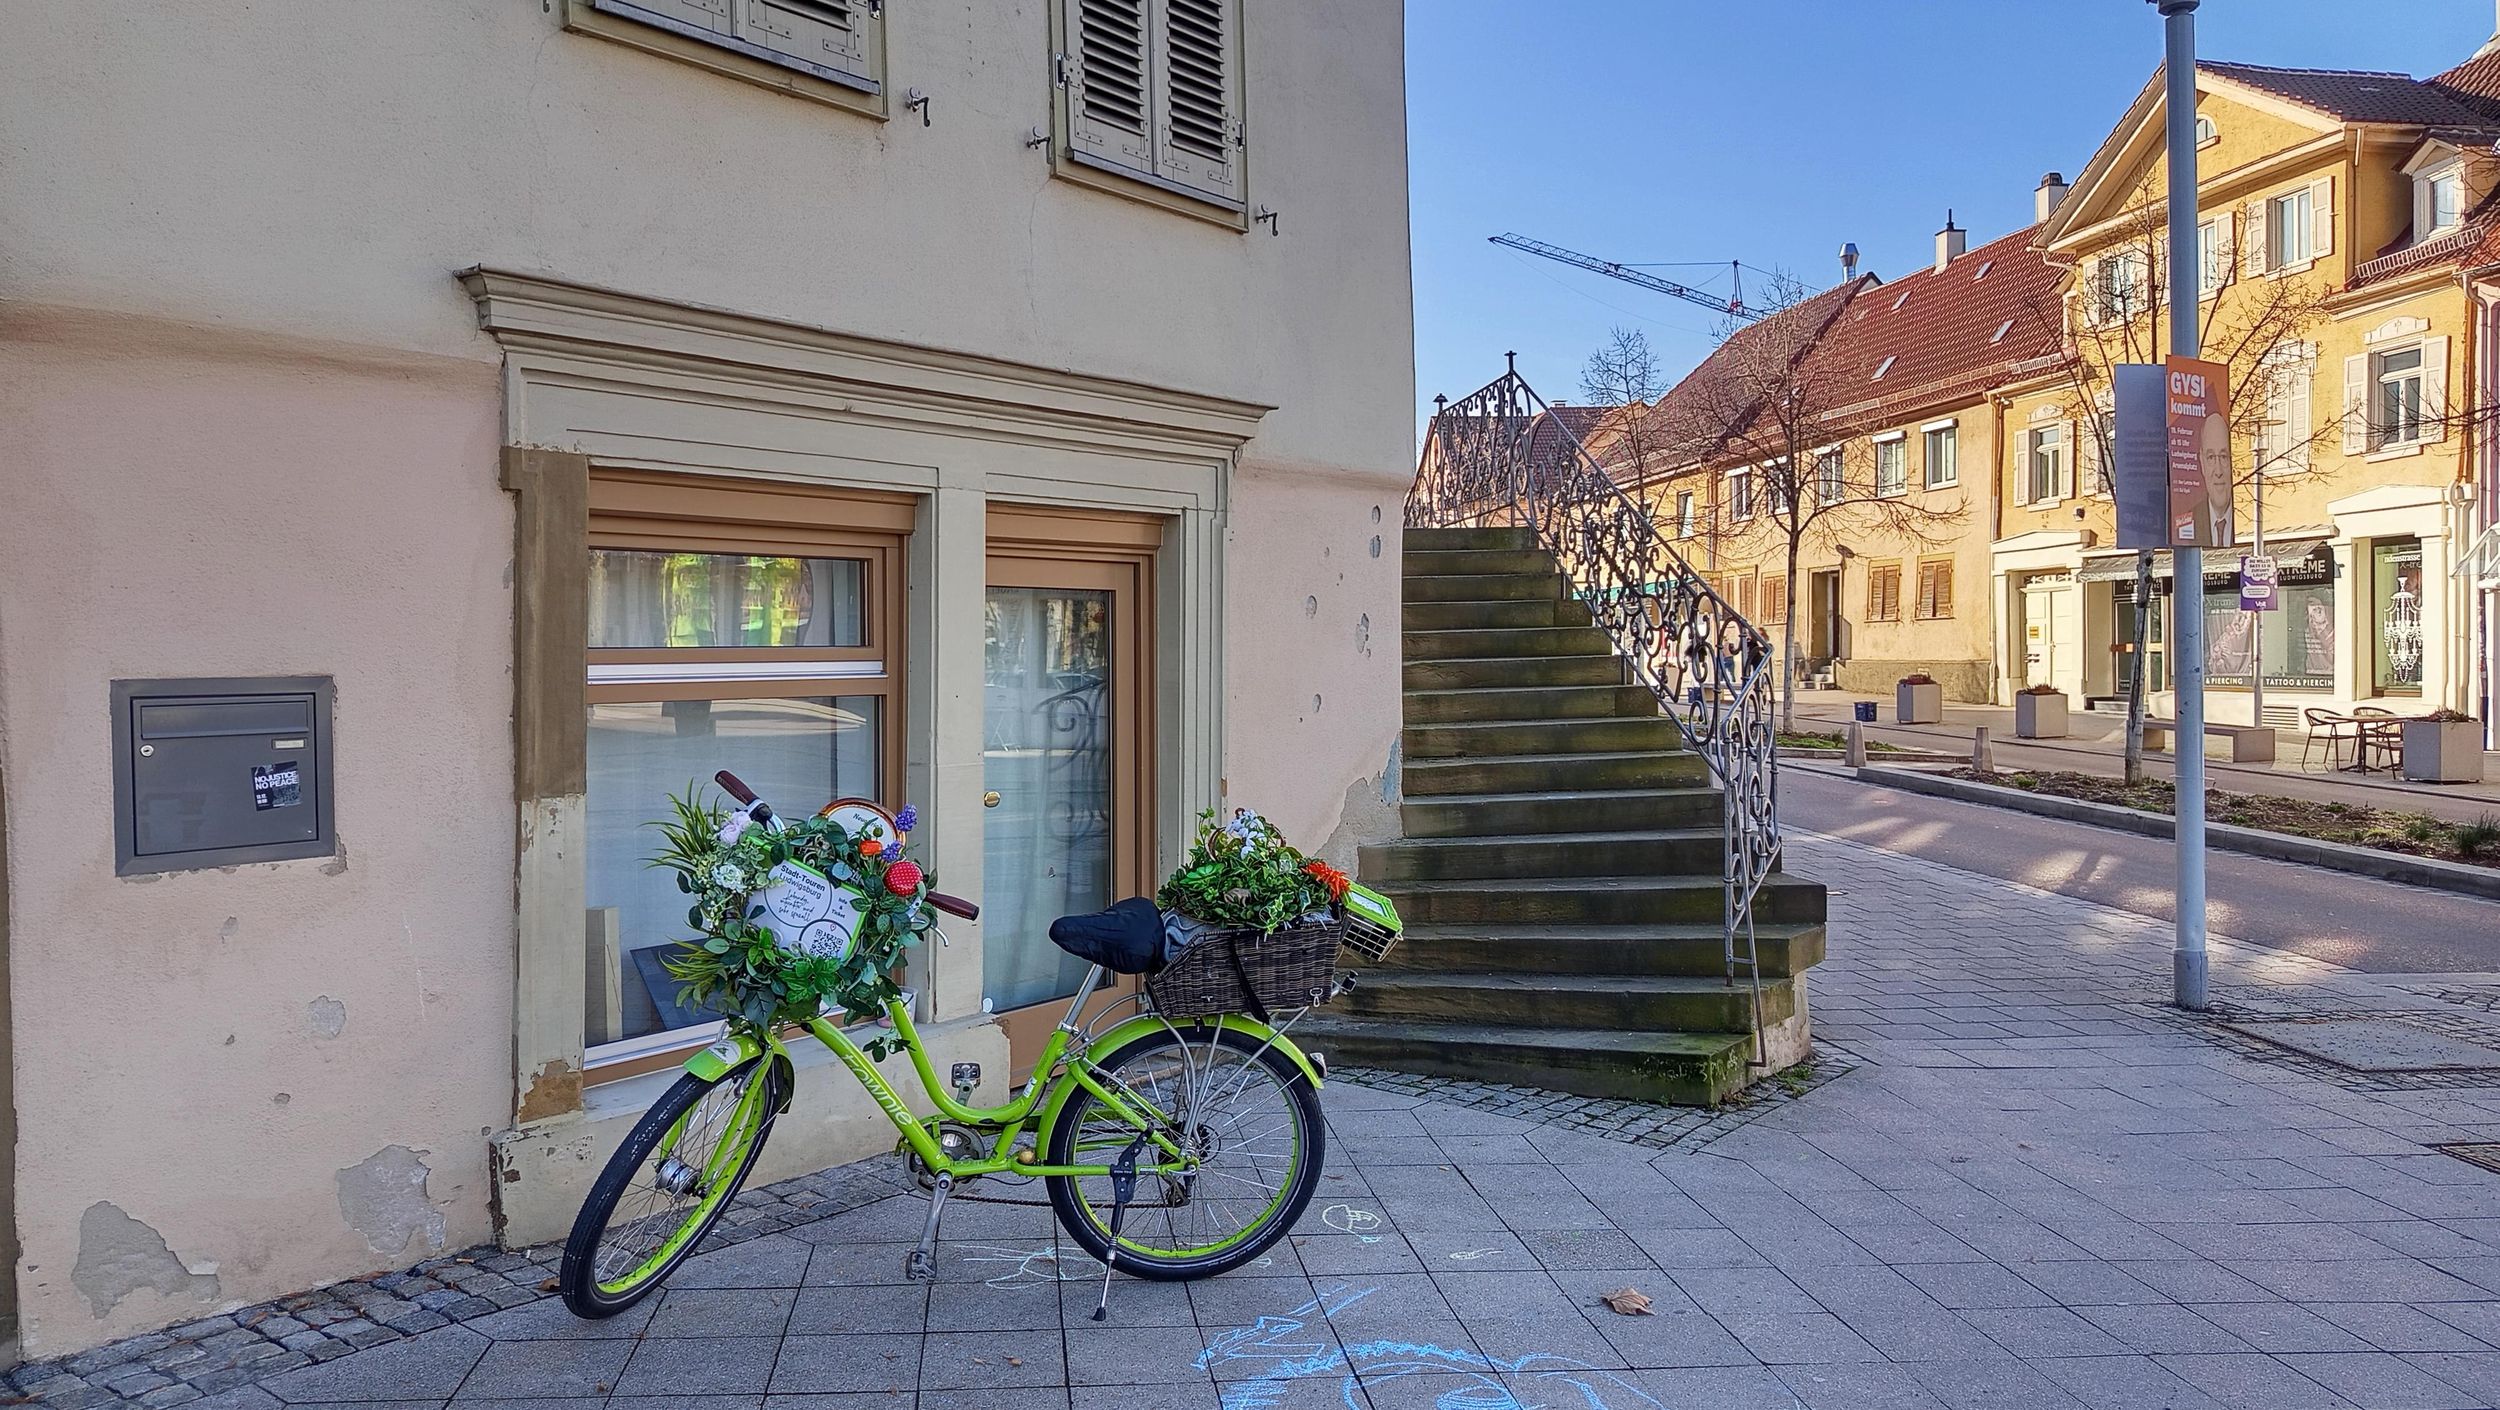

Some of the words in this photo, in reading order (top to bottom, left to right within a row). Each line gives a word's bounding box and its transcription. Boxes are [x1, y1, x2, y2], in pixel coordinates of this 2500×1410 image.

[2170, 371, 2206, 398] GYSI
[2170, 397, 2207, 418] kommt
[2279, 573, 2323, 581] LUDWIGSBURG
[2211, 677, 2243, 685] PIERCING
[2265, 678, 2295, 686] TATTOO
[2296, 678, 2302, 686] &
[255, 781, 269, 790] NO
[269, 777, 299, 788] PEACE
[779, 872, 822, 899] Ludwigsburg
[780, 864, 826, 892] Stadt-Touren
